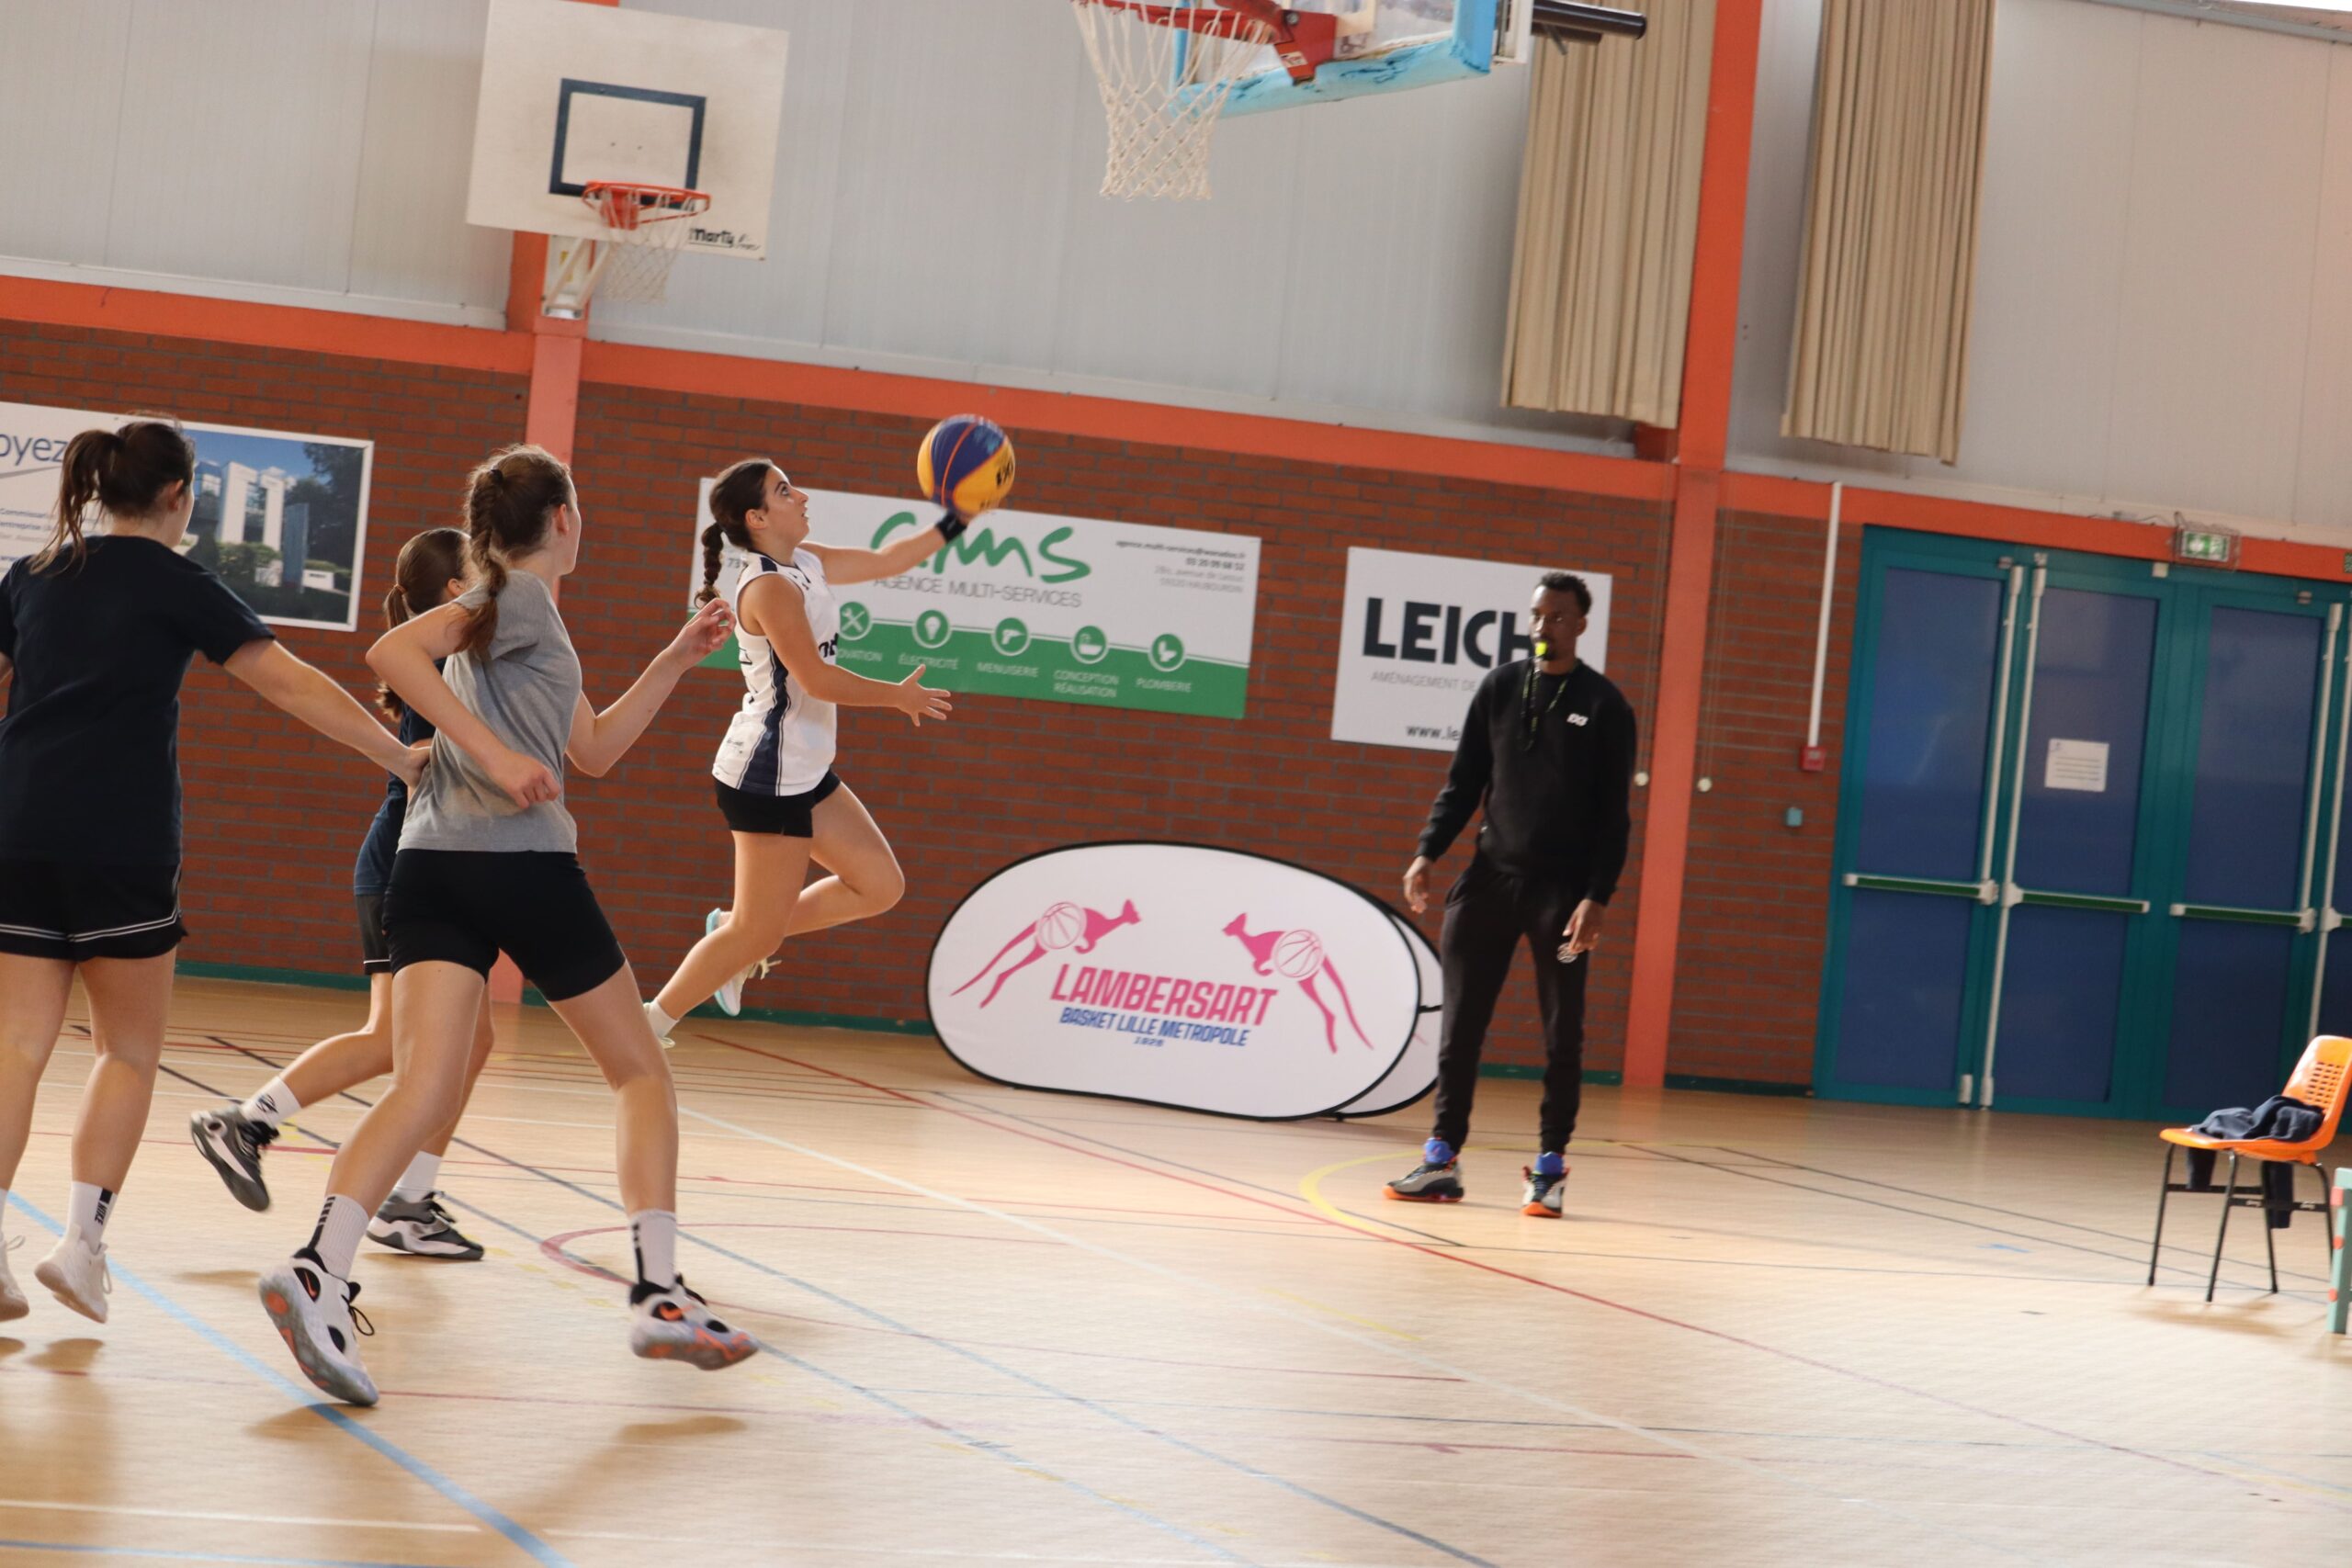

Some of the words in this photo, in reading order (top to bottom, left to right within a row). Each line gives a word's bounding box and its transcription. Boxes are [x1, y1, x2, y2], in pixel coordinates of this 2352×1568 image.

[874, 576, 942, 593] AGENCE
[948, 581, 1082, 608] MULTI-SERVICES
[1050, 964, 1278, 1025] LAMBERSART
[1059, 1007, 1116, 1030] BASKET
[1116, 1015, 1160, 1035] LILLE
[1159, 1020, 1251, 1046] METROPOLE
